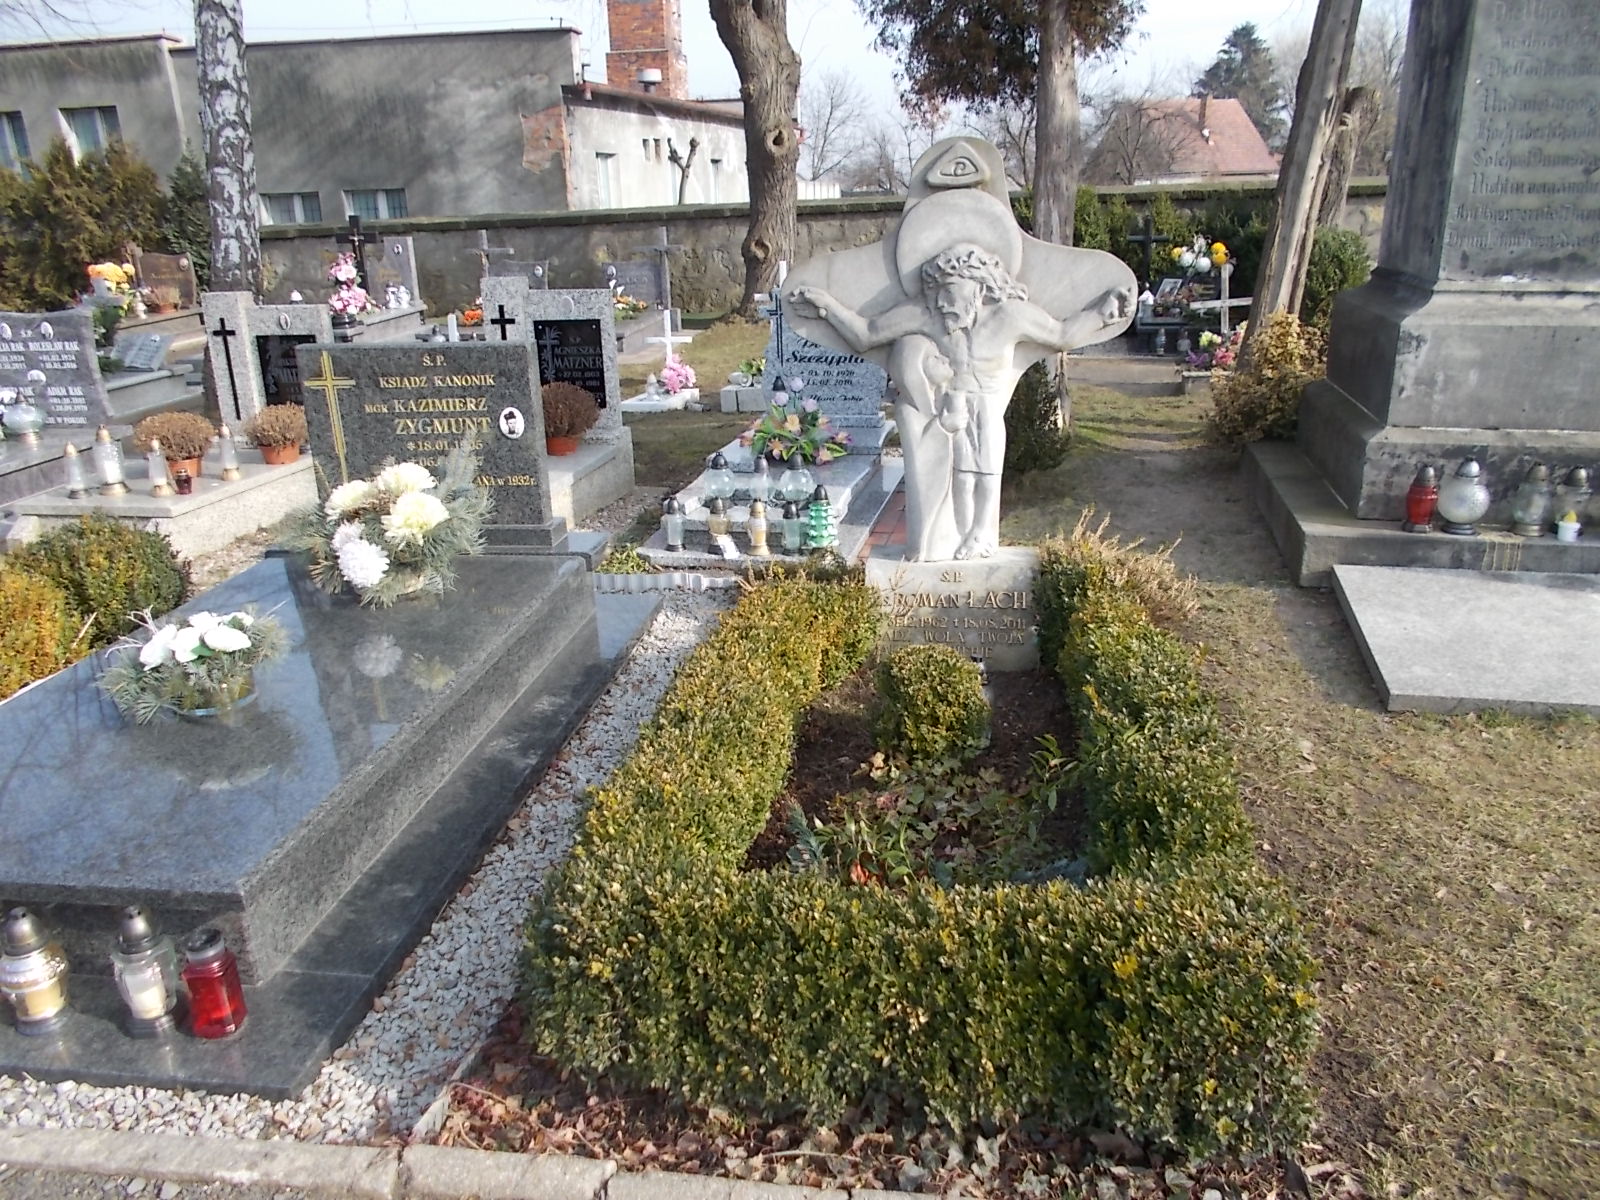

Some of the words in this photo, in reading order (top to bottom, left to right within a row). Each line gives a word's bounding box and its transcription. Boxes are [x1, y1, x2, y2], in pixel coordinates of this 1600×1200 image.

[554, 346, 601, 354] AGNIESZKA
[554, 356, 603, 369] MATZNER
[434, 374, 496, 388] KANONIK
[394, 397, 488, 414] KAZIMIERZ
[394, 417, 491, 435] ZYGMUNT
[967, 590, 1027, 610] ŁACH
[924, 631, 965, 643] WOLA
